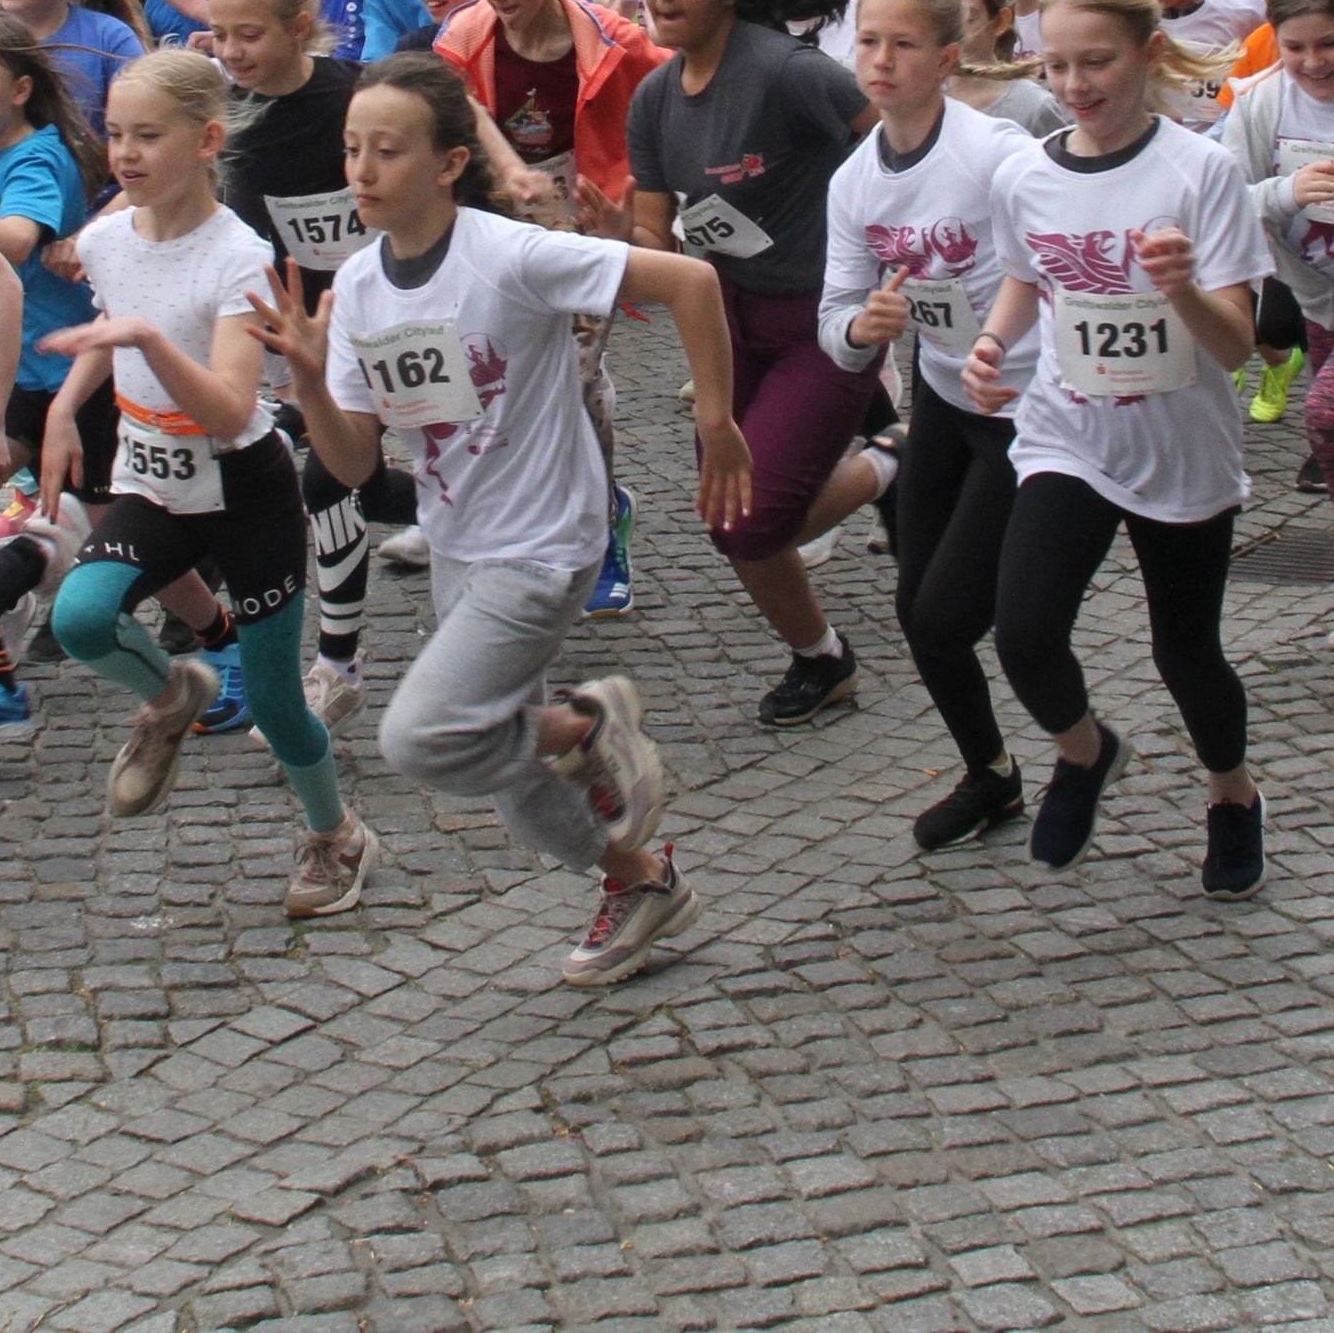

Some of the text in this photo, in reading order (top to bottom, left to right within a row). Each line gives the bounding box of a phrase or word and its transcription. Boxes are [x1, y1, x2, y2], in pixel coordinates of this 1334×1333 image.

[288, 208, 367, 244] 1574
[1074, 318, 1169, 358] 1231
[358, 347, 451, 393] 1162
